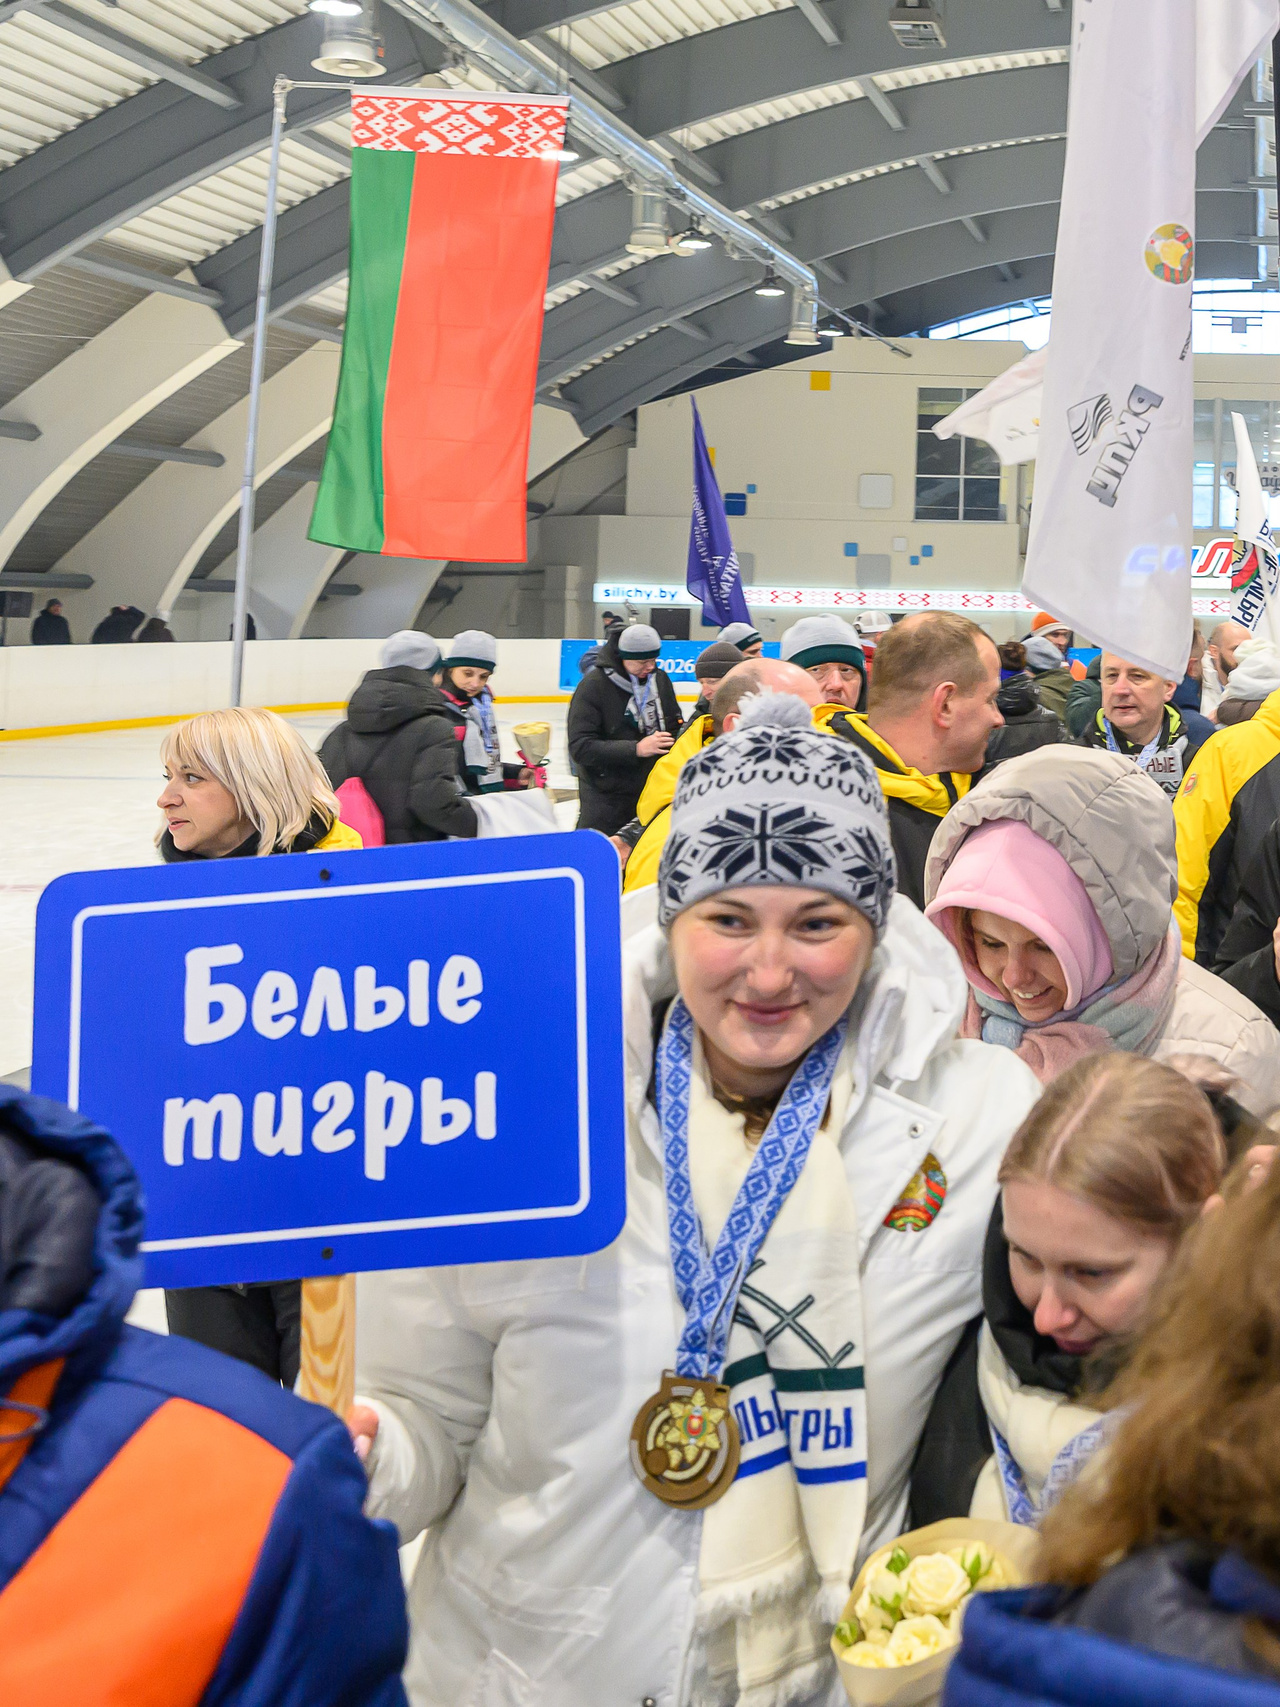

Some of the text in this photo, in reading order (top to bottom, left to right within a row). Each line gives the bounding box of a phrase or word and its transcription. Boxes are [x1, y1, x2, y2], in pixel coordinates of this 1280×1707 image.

[603, 587, 678, 600] silichy.by
[655, 658, 696, 673] 2026
[182, 942, 484, 1047] Белые
[162, 1070, 498, 1180] тигры
